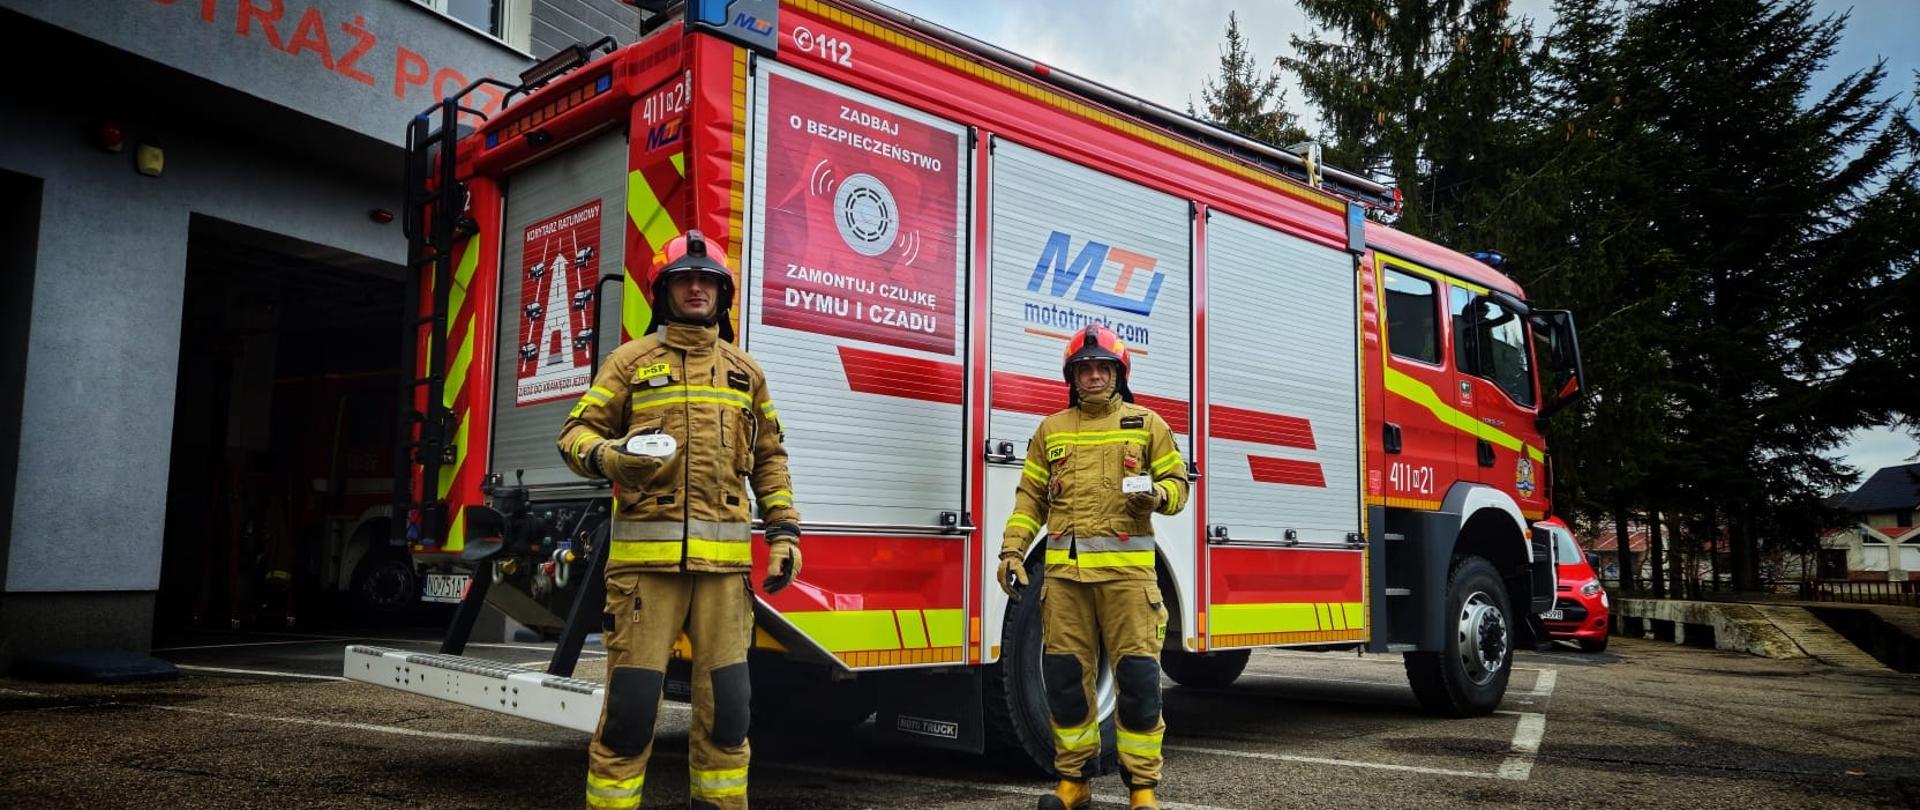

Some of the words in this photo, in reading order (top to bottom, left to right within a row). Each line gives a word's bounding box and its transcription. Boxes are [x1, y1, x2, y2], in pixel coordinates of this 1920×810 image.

[155, 0, 376, 86] RAŻ
[815, 34, 853, 68] 112
[840, 105, 899, 136] ZADBAJ
[790, 115, 801, 129] O
[807, 119, 941, 172] BEZPIECZEŃSTWO
[786, 264, 874, 295] ZAMONTUJ
[880, 283, 936, 311] CZUJKĘ
[785, 287, 849, 317] DYMU
[856, 301, 862, 320] I
[869, 304, 936, 333] CZADU
[643, 365, 665, 376] PSP
[1050, 447, 1064, 459] PSP
[922, 722, 954, 736] TRUCK
